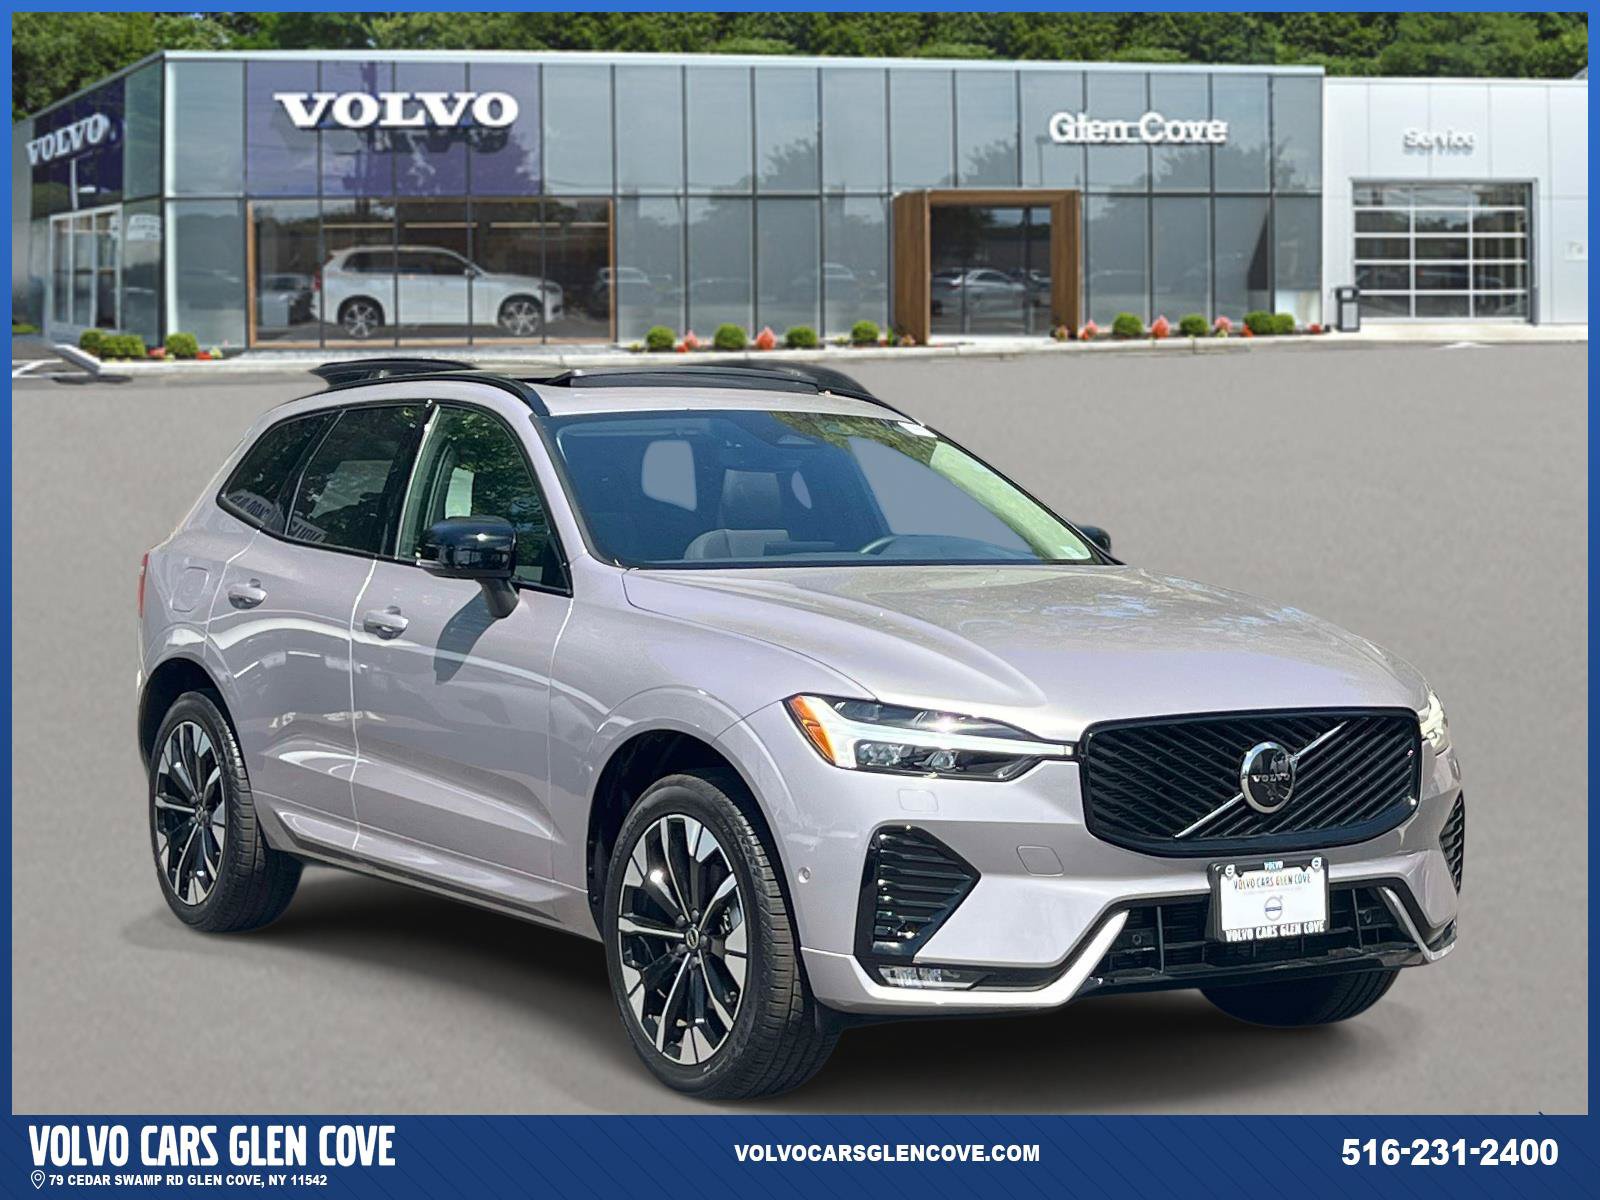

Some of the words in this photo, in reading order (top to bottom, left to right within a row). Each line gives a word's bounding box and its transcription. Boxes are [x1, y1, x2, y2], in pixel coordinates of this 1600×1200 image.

[273, 91, 519, 128] VOLVO
[25, 112, 110, 165] VOLVO
[1049, 111, 1128, 144] Glen
[1138, 111, 1228, 144] Cove
[1403, 129, 1475, 154] Service
[1251, 773, 1291, 784] VOLVO
[1233, 877, 1255, 890] VOLVO
[1256, 876, 1274, 888] CARS
[1275, 874, 1293, 886] GLEN
[1294, 872, 1312, 884] COVE
[1225, 928, 1254, 942] VOLVO
[1255, 925, 1278, 938] CARS
[1279, 922, 1301, 936] GLEN
[1303, 919, 1325, 933] COVE
